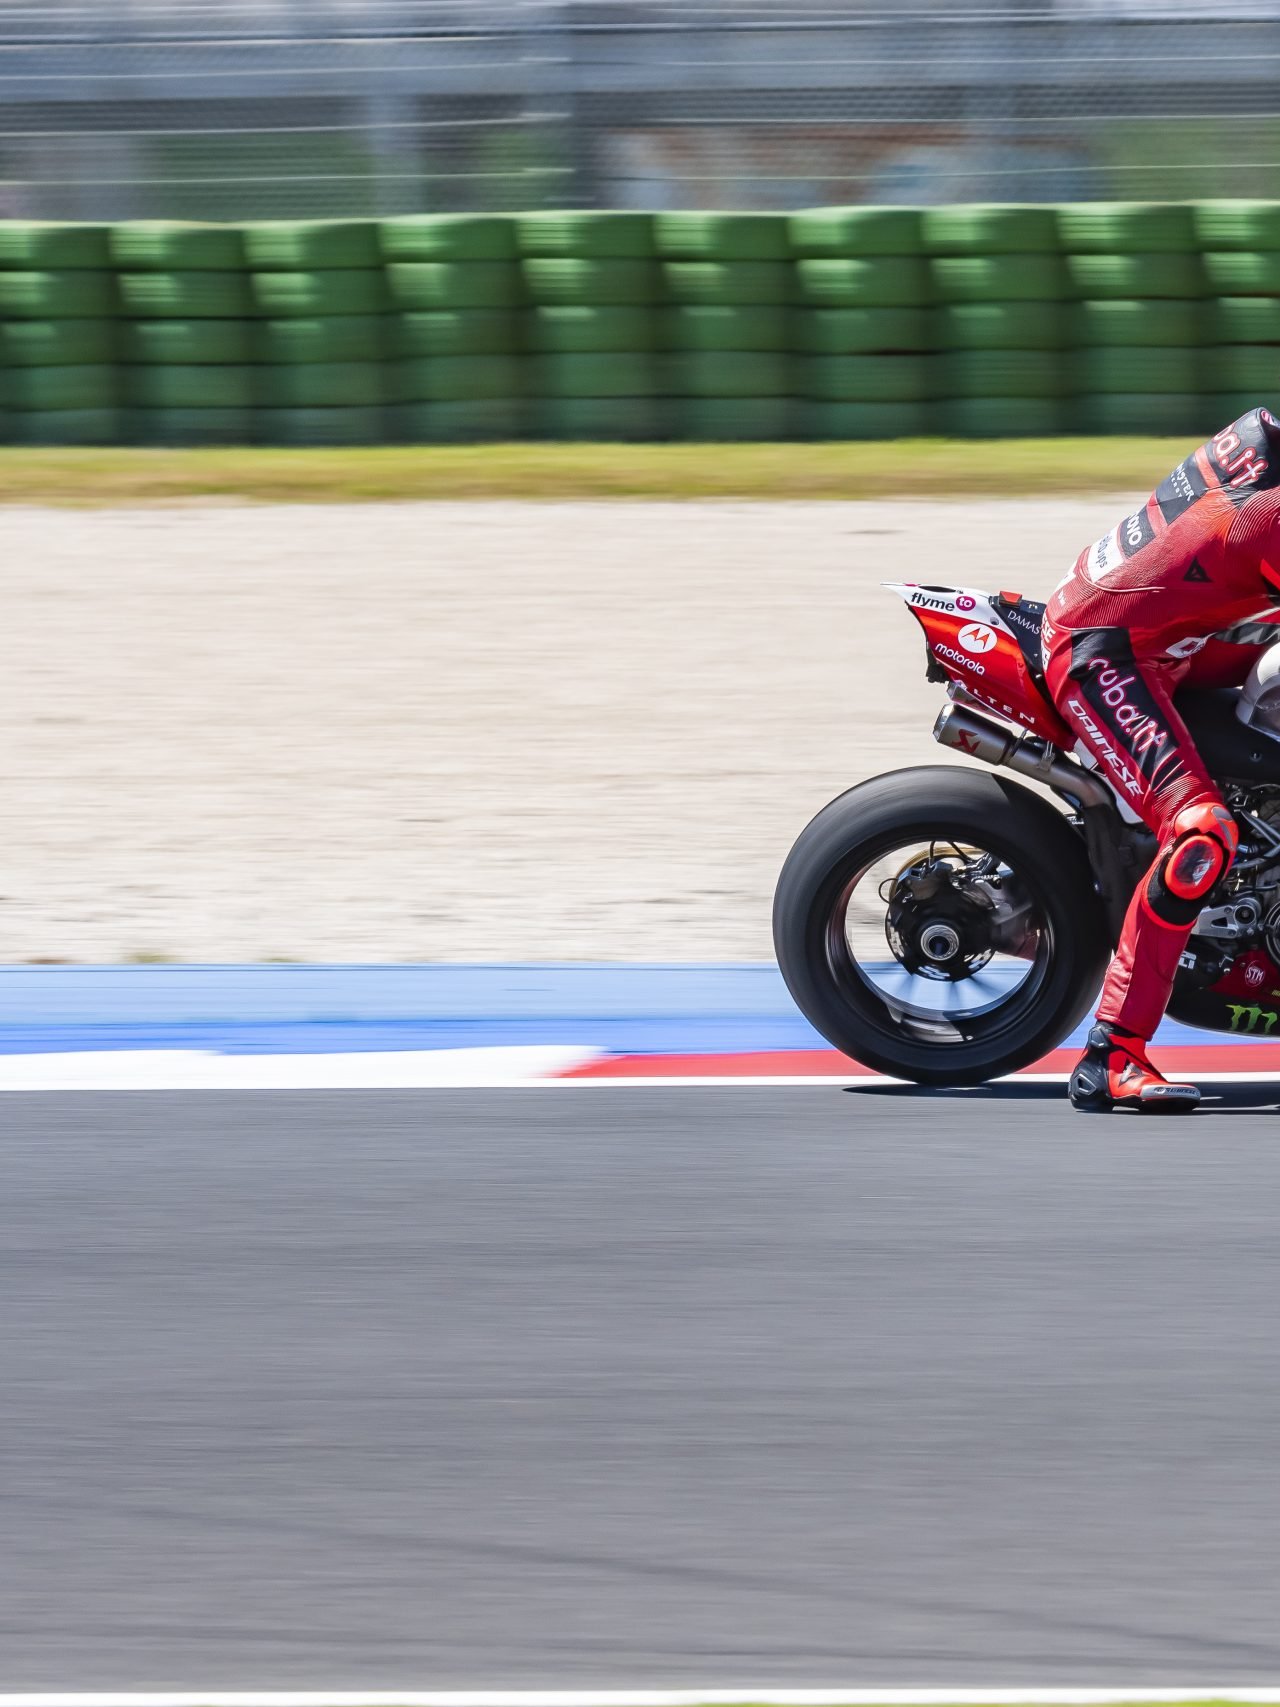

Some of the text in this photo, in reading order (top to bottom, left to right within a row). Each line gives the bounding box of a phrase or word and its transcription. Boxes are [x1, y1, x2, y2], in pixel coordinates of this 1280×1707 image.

[1174, 462, 1195, 502] NSTER
[911, 592, 973, 612] flyme to
[935, 643, 986, 676] motorola
[1068, 700, 1144, 797] DAINESE
